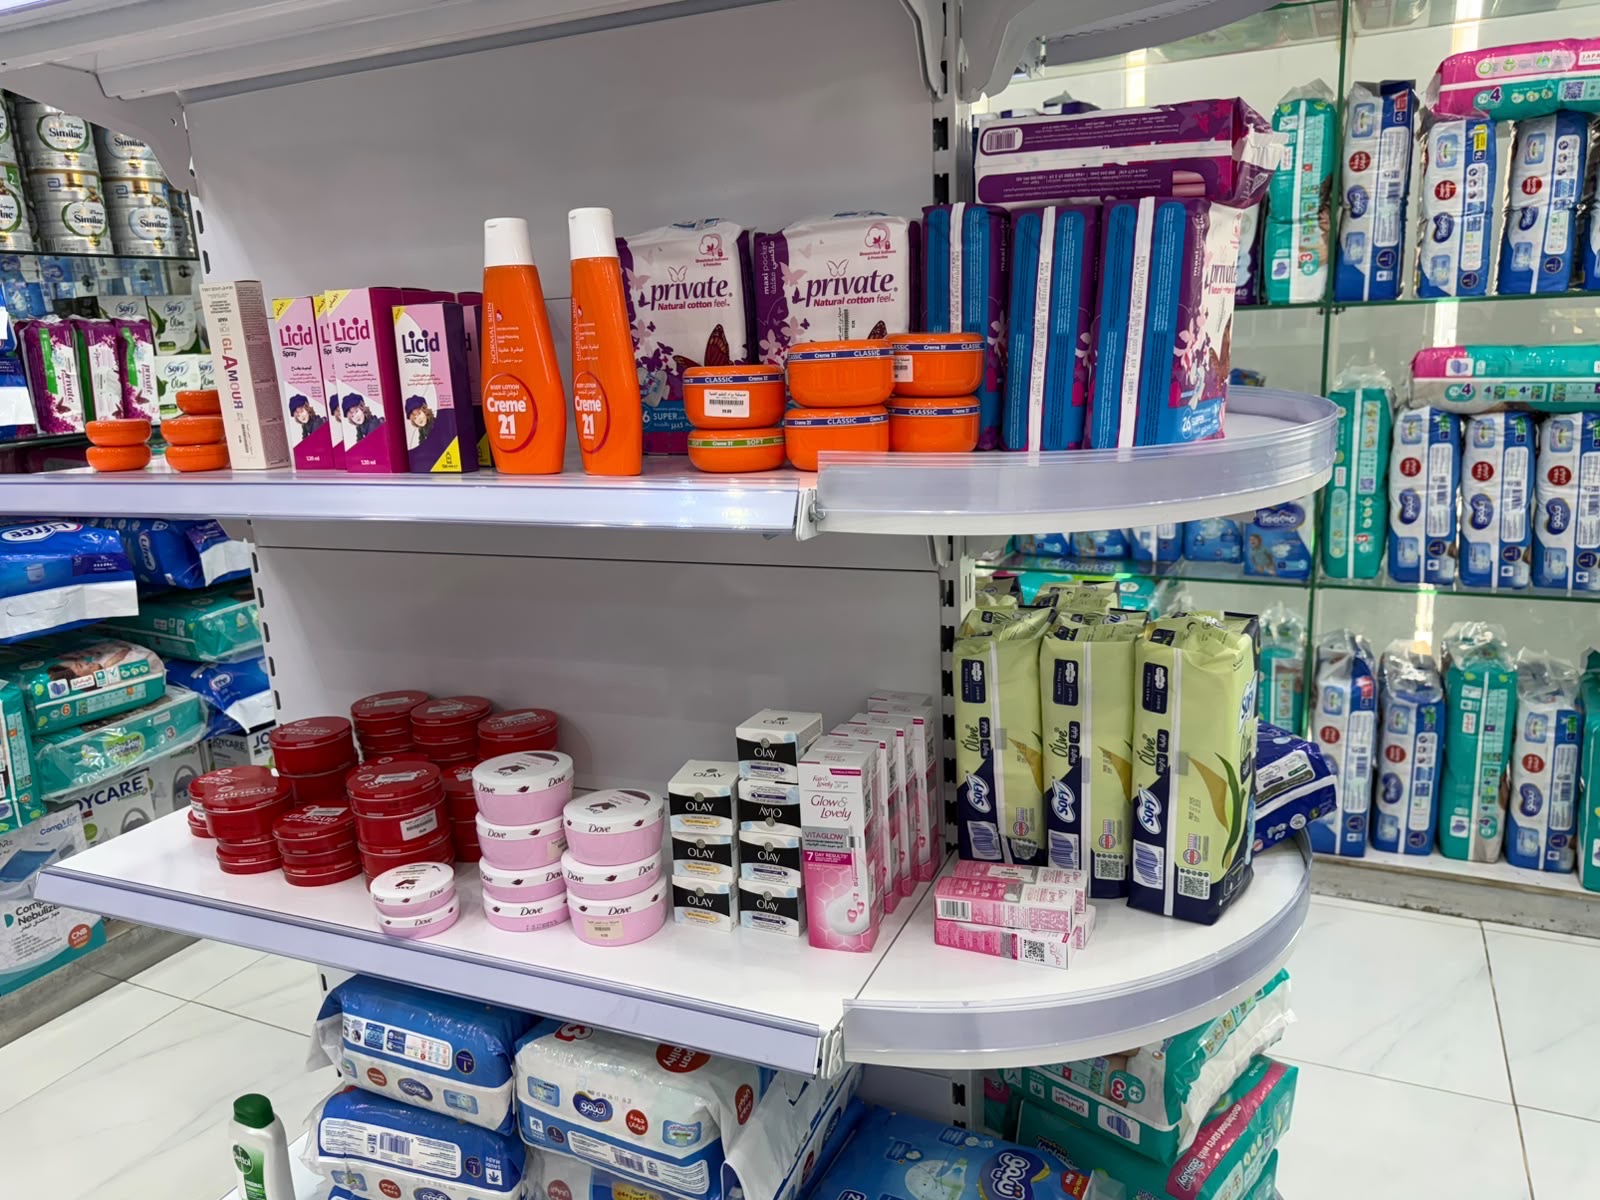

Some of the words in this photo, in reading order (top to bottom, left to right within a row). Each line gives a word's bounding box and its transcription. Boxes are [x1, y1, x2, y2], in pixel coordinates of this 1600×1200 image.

[1582, 52, 1600, 60] JAPA
[1489, 87, 1501, 103] 4
[49, 127, 83, 140] Similac
[74, 214, 104, 225] Similac
[139, 219, 169, 230] Similac
[650, 276, 729, 312] private
[804, 269, 895, 309] private
[658, 302, 686, 312] Natural
[687, 299, 713, 310] cotton
[714, 297, 728, 308] feel
[813, 296, 845, 308] Natural
[846, 294, 875, 306] cotton
[876, 292, 892, 304] feel
[279, 324, 313, 347] Licid
[333, 317, 371, 343] Licid
[401, 329, 441, 354] Licid
[489, 325, 497, 365] NORMAL
[282, 350, 297, 359] Spray
[335, 346, 352, 355] Spray
[853, 349, 881, 357] CLASSIC
[404, 357, 429, 366] Shampoo
[1461, 383, 1472, 396] 4
[487, 397, 526, 414] Creme
[575, 396, 602, 413] Creme
[652, 411, 678, 421] SUPER
[908, 408, 938, 416] CLASSIC
[498, 414, 516, 435] 21
[582, 414, 595, 435] 21
[827, 417, 857, 425] CLASSIC
[11, 522, 72, 540] Lifree
[139, 534, 156, 571] Lifree
[61, 703, 72, 717] 6
[165, 727, 176, 739] 3
[754, 747, 777, 760] OLAY
[548, 774, 566, 788] Dove
[478, 783, 496, 794] Dove
[971, 781, 985, 806] SOFY
[685, 801, 714, 812] OLAY
[1055, 788, 1070, 816] SOFY
[759, 806, 782, 818] OLAY
[820, 807, 852, 822] Lovely
[1141, 797, 1156, 828] SOFY
[487, 828, 507, 840] Dove
[588, 823, 611, 834] Dove
[804, 831, 844, 842] VITAGLOW
[687, 848, 715, 859] OLAY
[757, 851, 781, 864] OLAY
[806, 851, 813, 861] 7
[638, 861, 656, 876] Dove
[567, 870, 584, 883] Dove
[687, 896, 714, 907] OLAY
[756, 900, 779, 913] OLAY
[519, 906, 544, 918] Dove
[608, 905, 632, 917] Dove
[414, 916, 433, 928] Dove
[679, 1047, 697, 1068] pan
[1109, 1077, 1126, 1099] 3
[580, 1101, 606, 1117] تيمو
[991, 1151, 1032, 1200] تيمو
